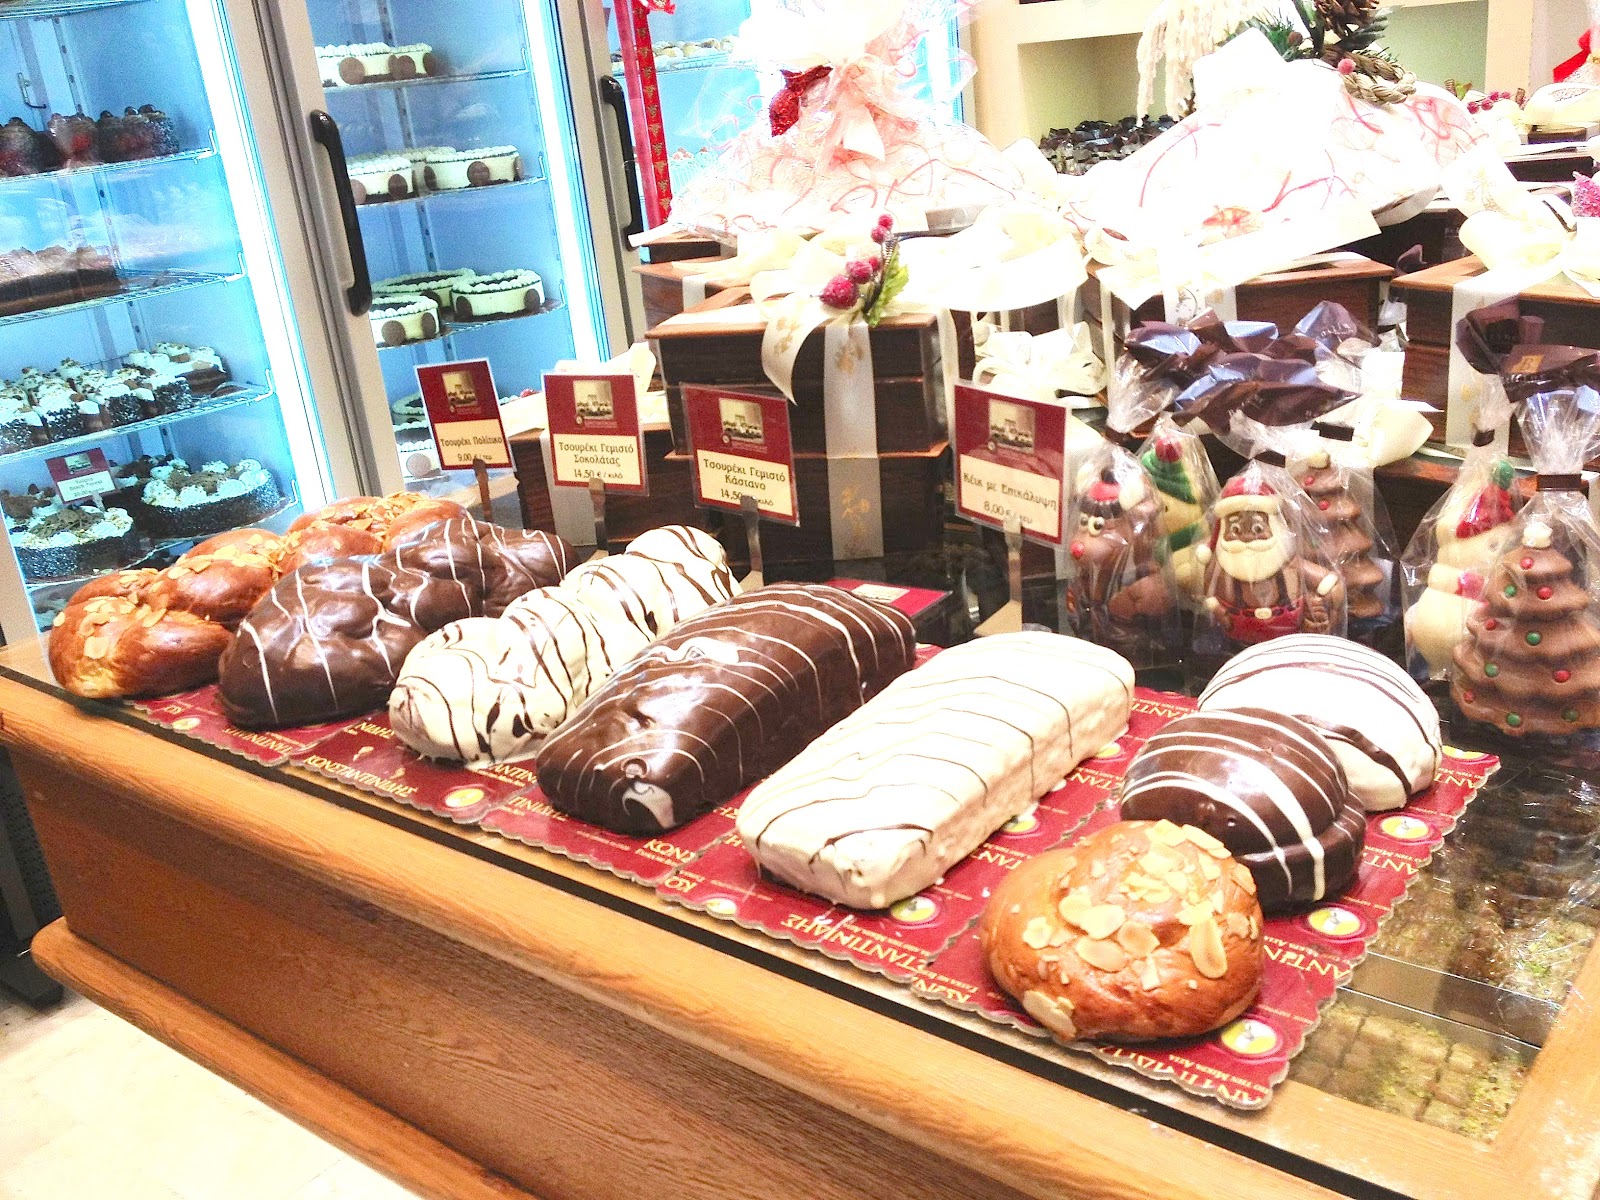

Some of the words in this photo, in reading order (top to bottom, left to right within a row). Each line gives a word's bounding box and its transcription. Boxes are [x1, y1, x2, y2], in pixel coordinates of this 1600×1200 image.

[558, 441, 598, 454] Τσουρέκι
[600, 443, 634, 455] Γεμιστό
[574, 453, 621, 467] Σοκολάτας
[703, 458, 747, 475] Τσουρέκι
[749, 466, 786, 482] Γεμιστό
[724, 474, 767, 491] Κάστανο
[1001, 482, 1057, 511] Επικάλυψη
